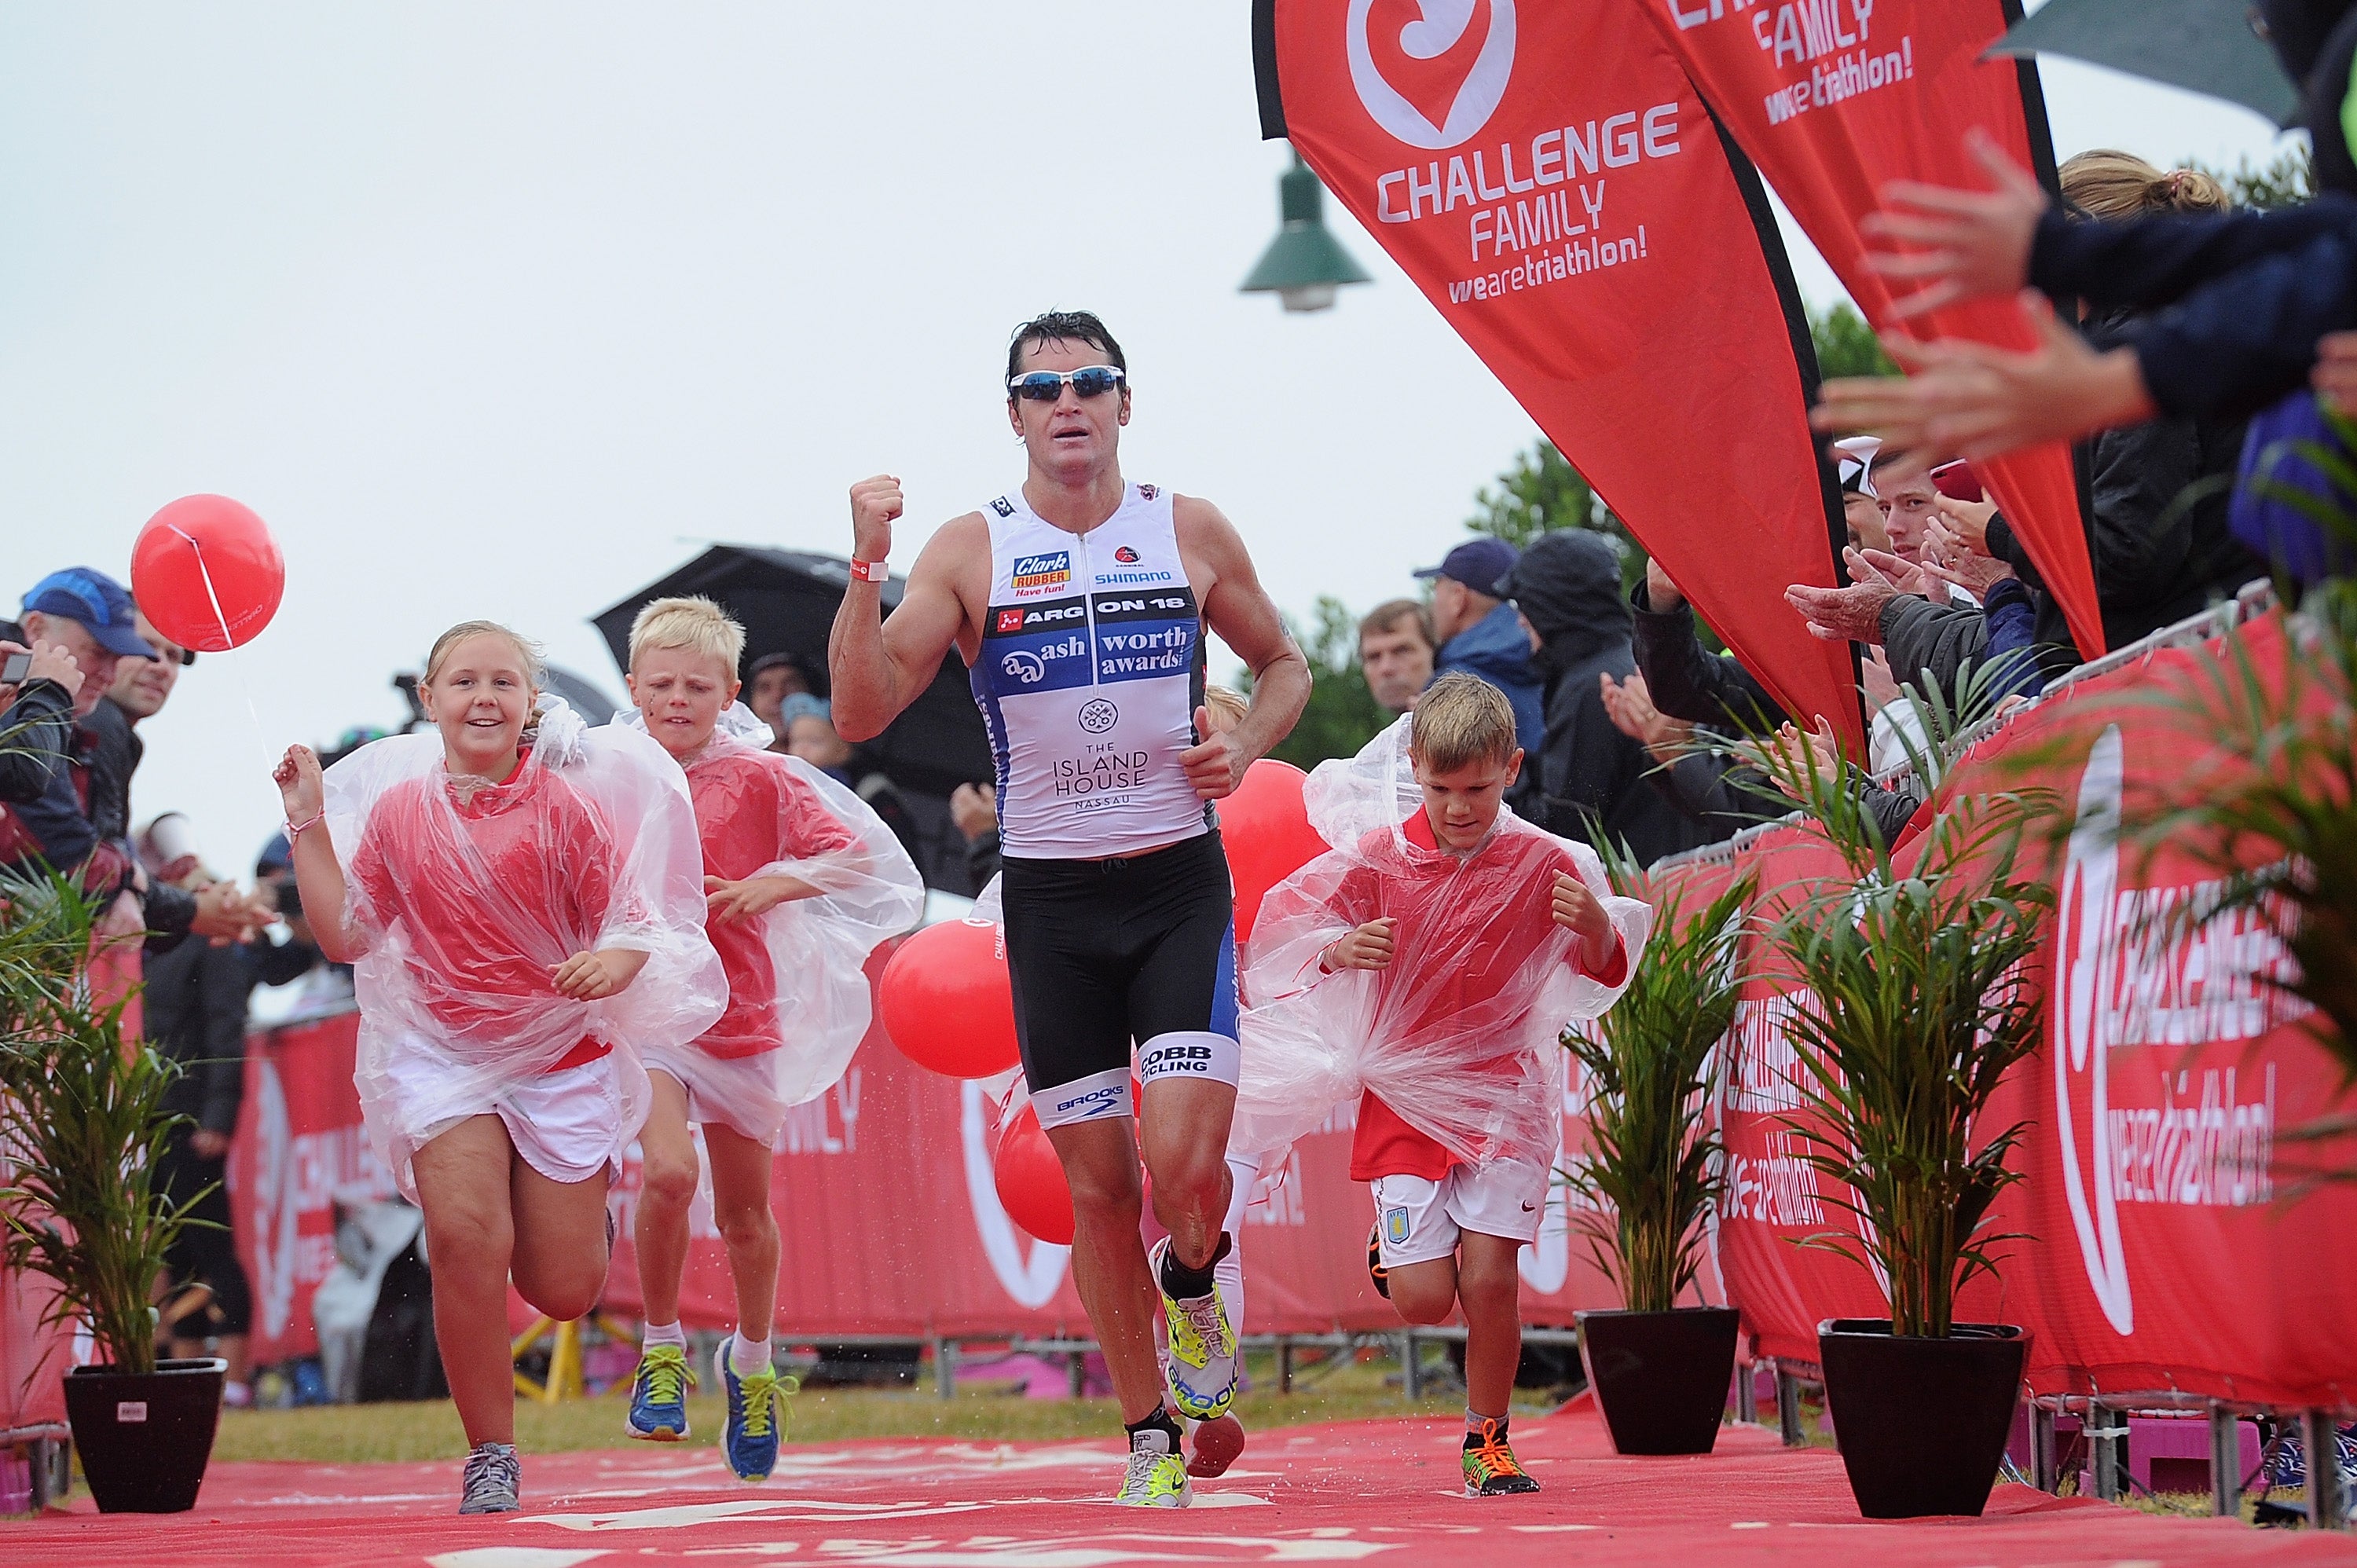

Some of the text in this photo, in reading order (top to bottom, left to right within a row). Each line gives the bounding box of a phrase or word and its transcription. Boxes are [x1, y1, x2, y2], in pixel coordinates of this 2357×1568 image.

[1376, 102, 1681, 224] CHALLENGE
[1469, 179, 1606, 262] FAMILY
[1448, 225, 1648, 304] wearetriathlon!
[1016, 553, 1067, 575] Clark
[1017, 571, 1065, 587] RUBBER
[1095, 571, 1171, 584] SHIMANO
[1016, 584, 1065, 597] Have fun!
[1149, 597, 1186, 609] 18
[1102, 650, 1178, 675] awards
[1086, 742, 1114, 754] THE
[1053, 751, 1148, 778] ISLAND
[1055, 769, 1146, 797] HOUSE
[1075, 795, 1130, 810] NASSAU
[1142, 1046, 1211, 1073] COBB
[1142, 1061, 1208, 1085] CYCLING
[1057, 1085, 1124, 1112] BROOKS
[1389, 1209, 1406, 1218] AVFC
